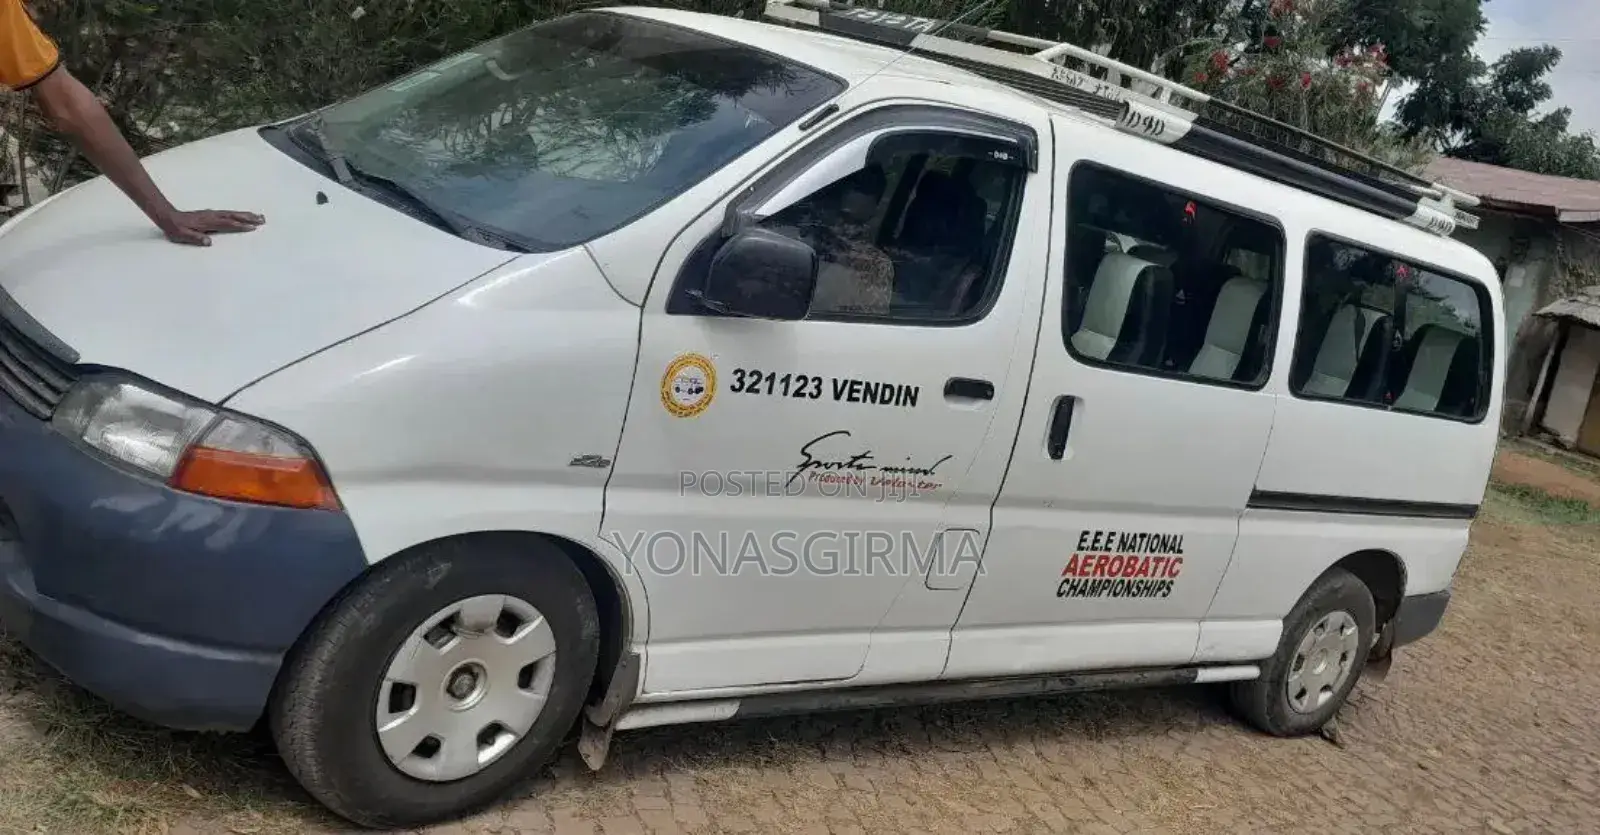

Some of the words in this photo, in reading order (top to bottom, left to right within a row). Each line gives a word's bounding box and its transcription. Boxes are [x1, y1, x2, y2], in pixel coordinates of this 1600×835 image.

[730, 367, 823, 400] 321123
[831, 377, 920, 408] VENDIN
[1076, 530, 1116, 552] E.E.E
[1116, 531, 1184, 554] NATIONAL
[1061, 553, 1184, 578] AEROBATIC
[1056, 578, 1174, 598] CHAMPIONSHIPS
